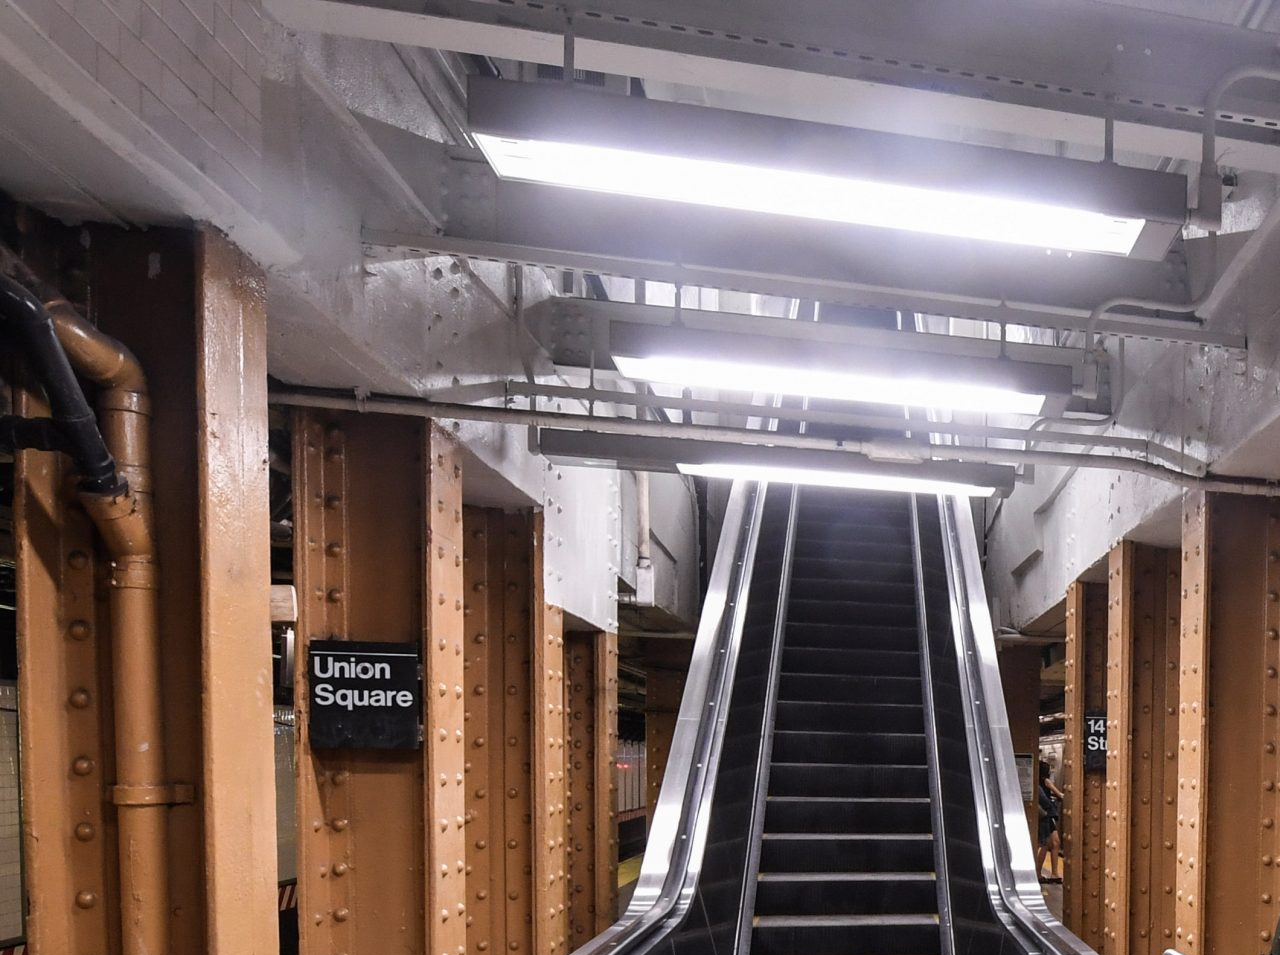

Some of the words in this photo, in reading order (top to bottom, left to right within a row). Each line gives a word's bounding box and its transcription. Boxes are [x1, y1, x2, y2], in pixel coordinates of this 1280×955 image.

[314, 656, 391, 679] Union
[314, 683, 414, 711] Square
[1087, 719, 1105, 733] 14
